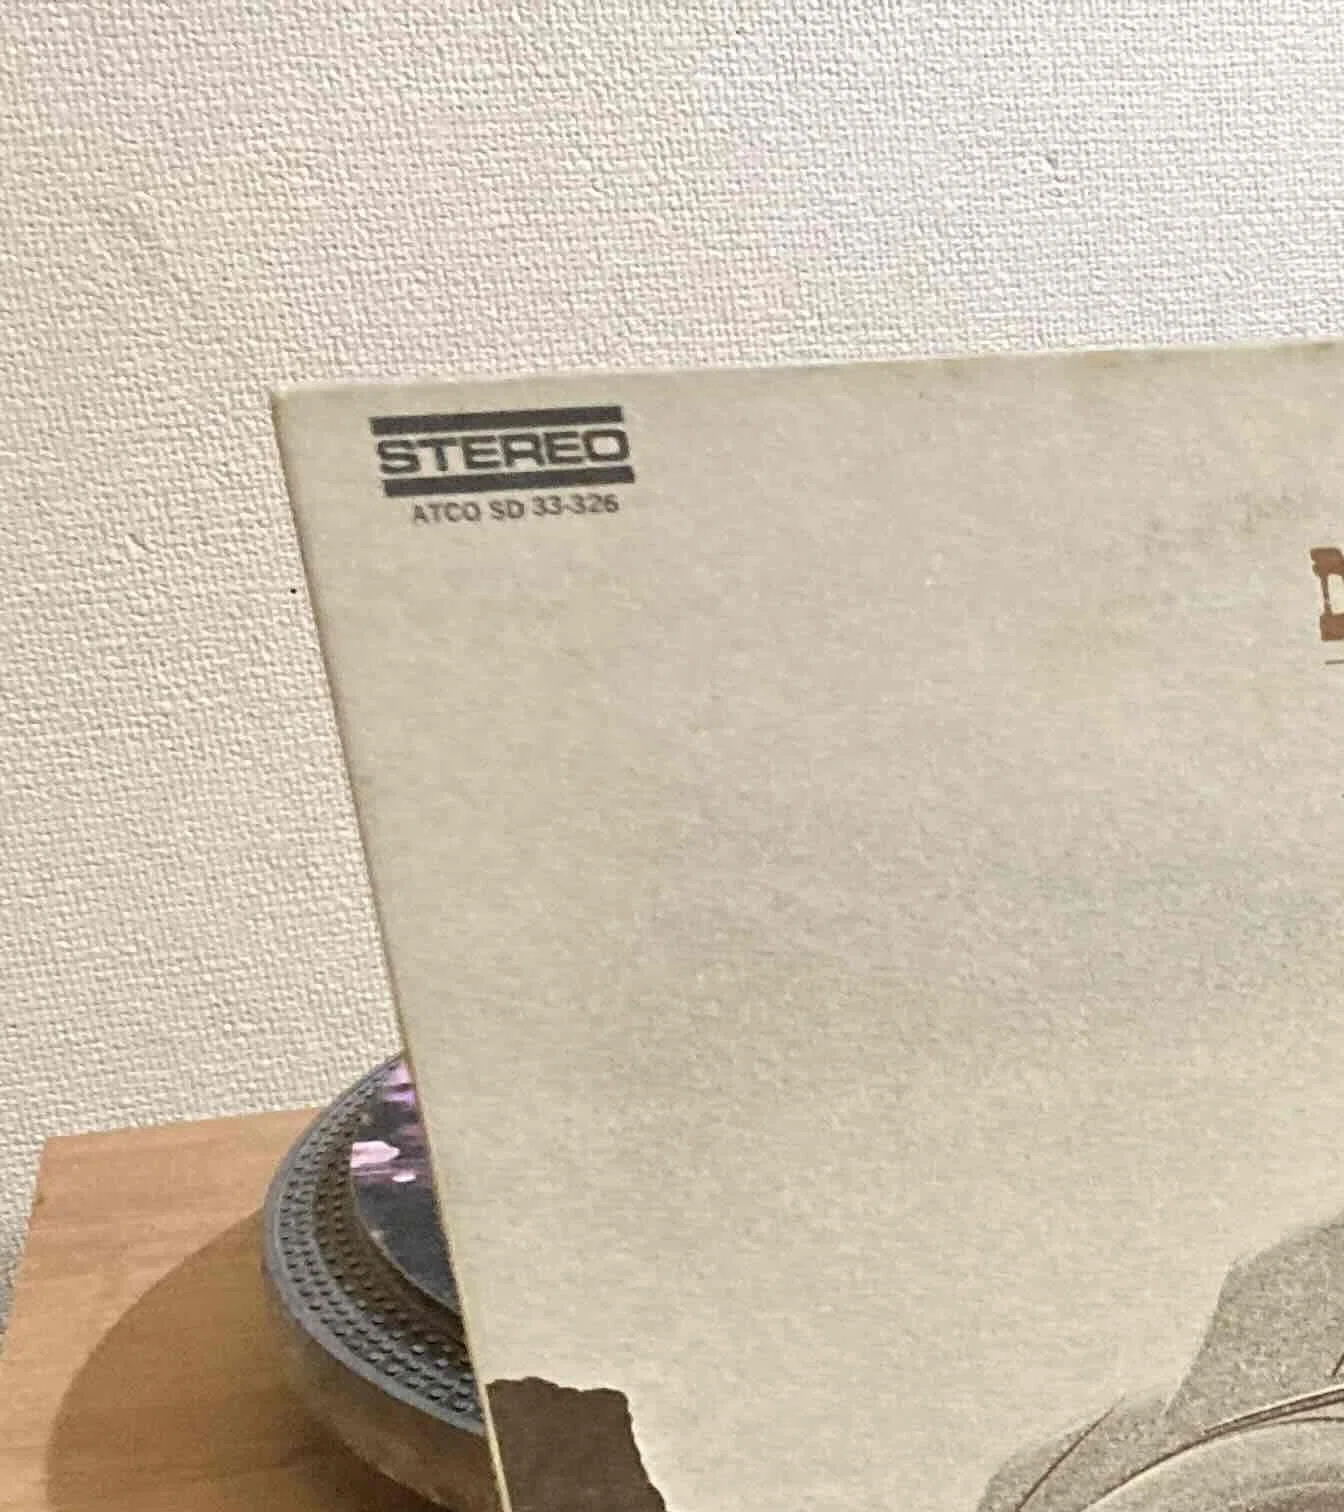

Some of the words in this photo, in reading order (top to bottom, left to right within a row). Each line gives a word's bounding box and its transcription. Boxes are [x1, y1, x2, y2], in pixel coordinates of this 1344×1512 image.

[377, 428, 630, 475] STEREO
[412, 501, 481, 525] ATCO
[489, 499, 525, 521] SD
[531, 493, 620, 518] 33-326
